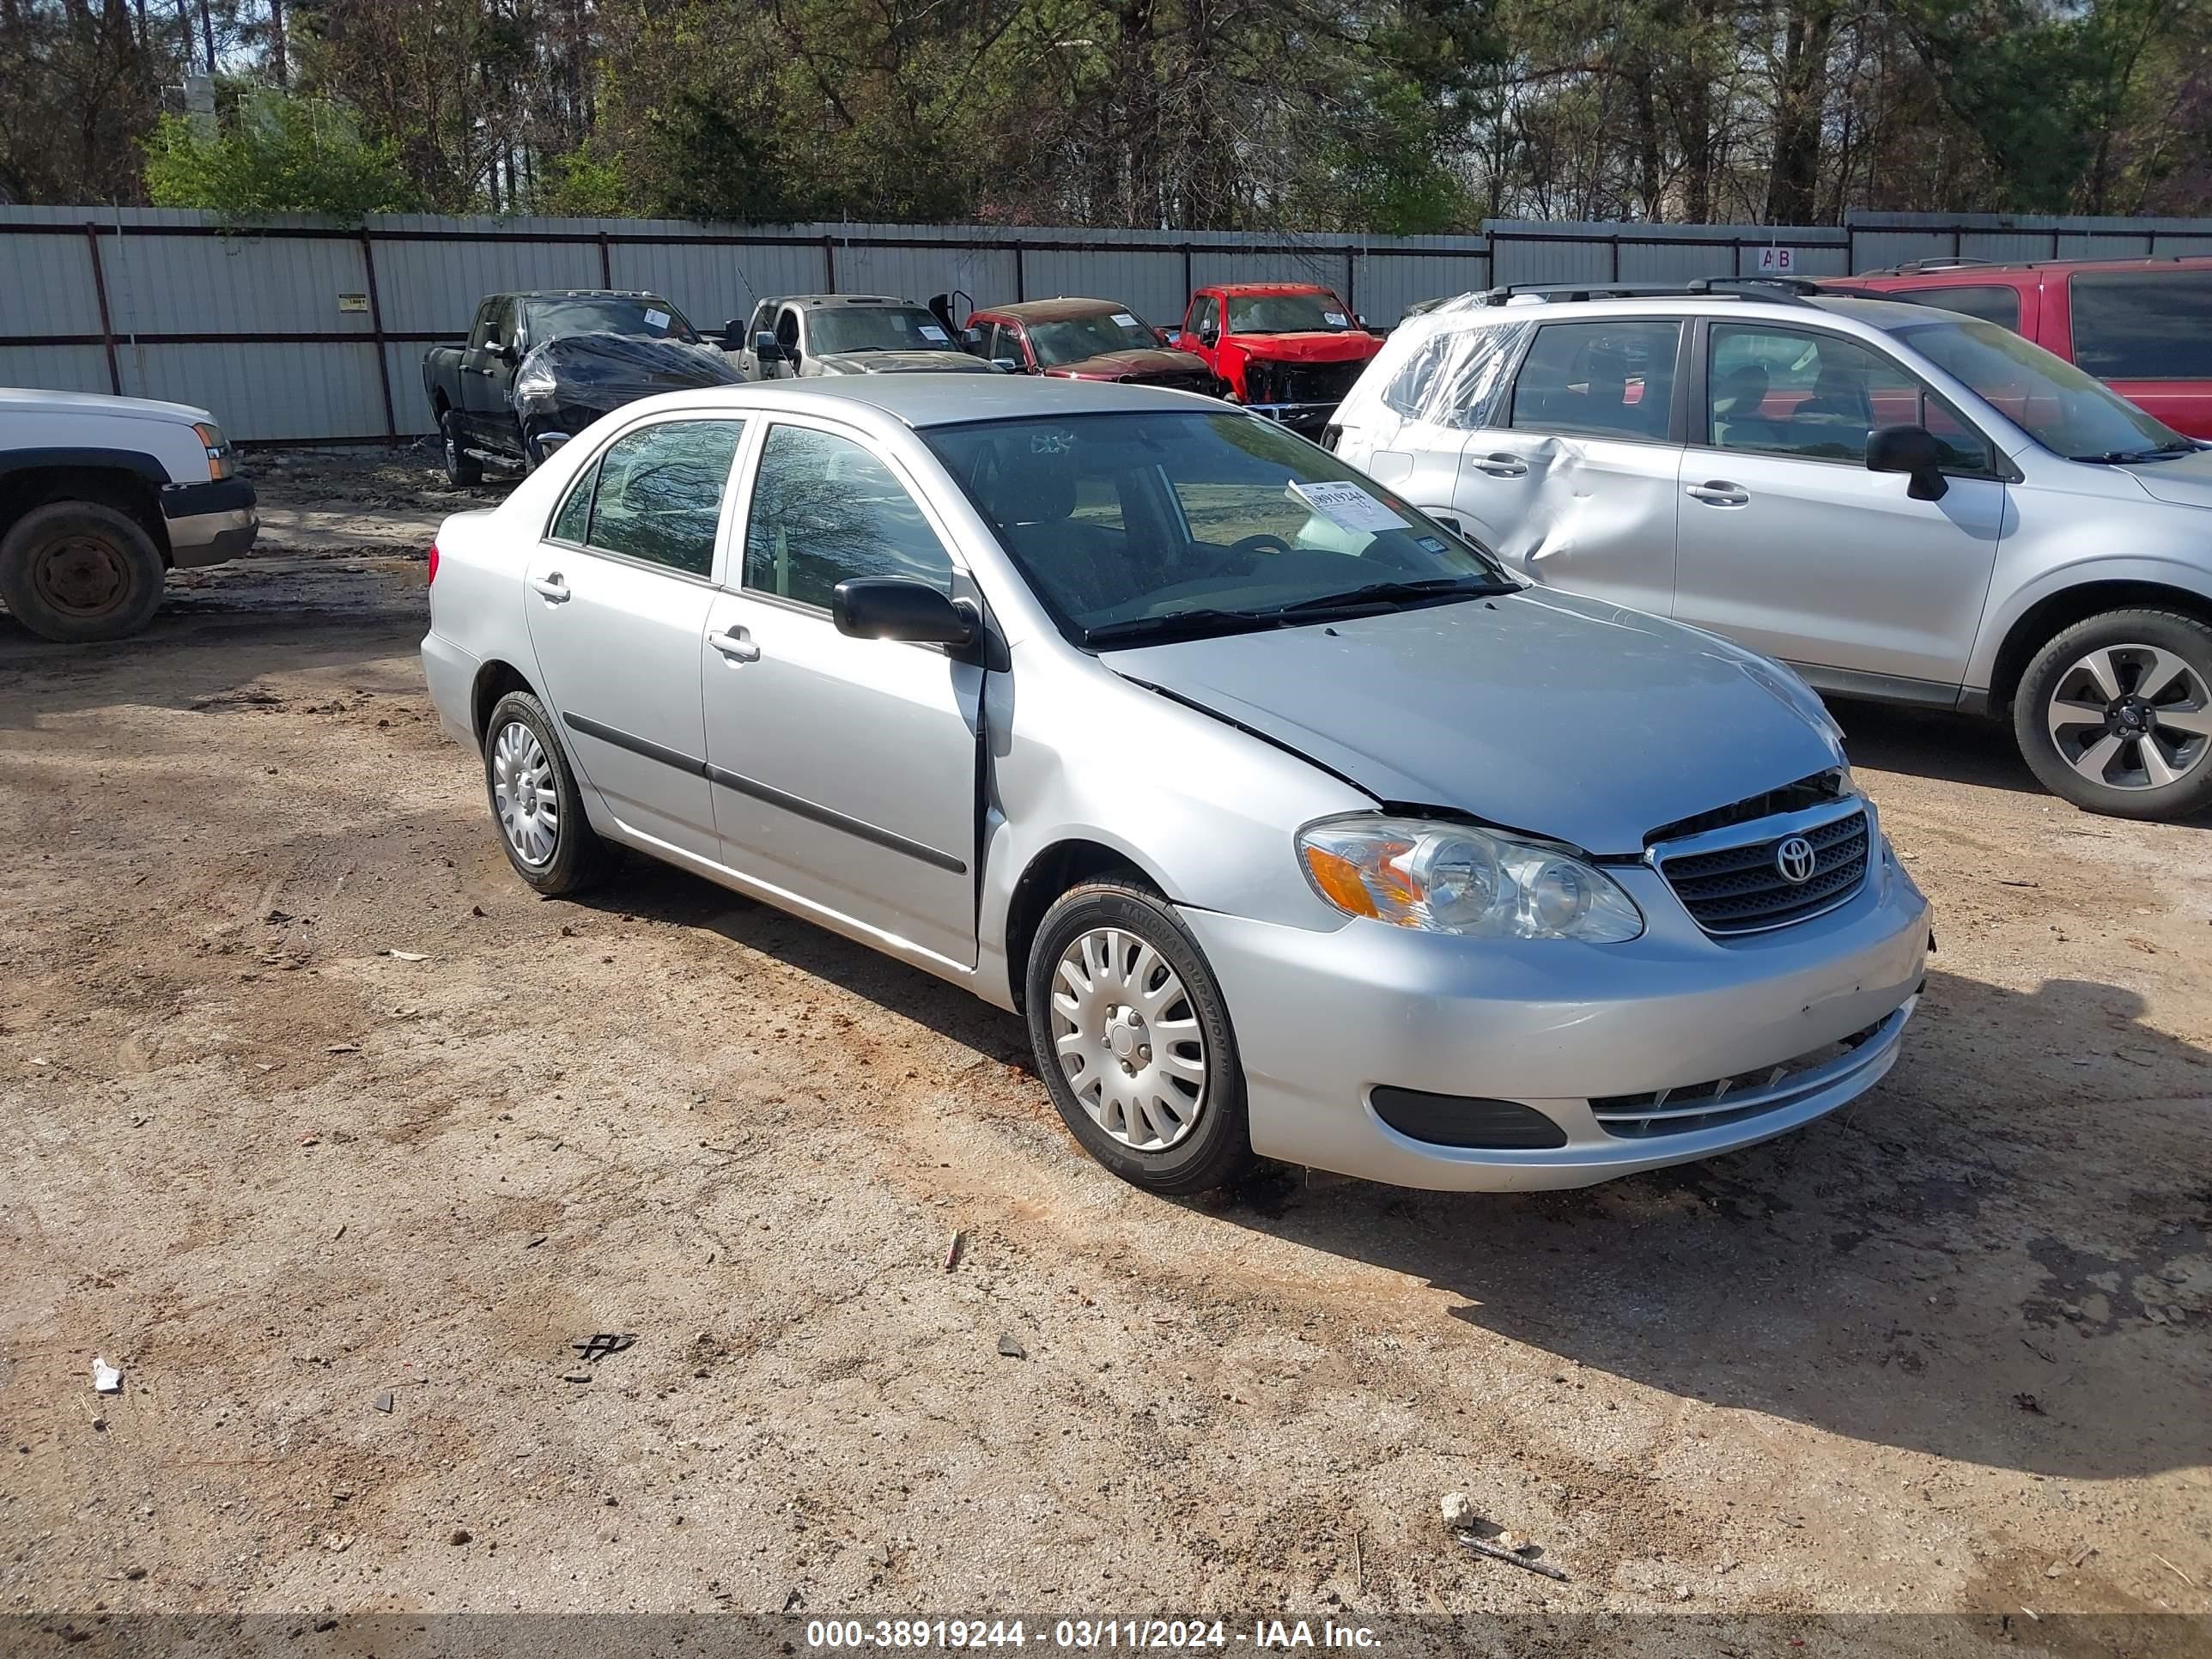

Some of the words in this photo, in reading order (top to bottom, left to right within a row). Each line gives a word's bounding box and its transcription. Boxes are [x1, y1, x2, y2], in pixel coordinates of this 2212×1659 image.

[1763, 250, 1772, 267] A
[1780, 250, 1790, 267] B
[1308, 491, 1367, 505] 38919244
[1120, 902, 1185, 959] NATIONAL
[1182, 959, 1226, 1052] DURATION
